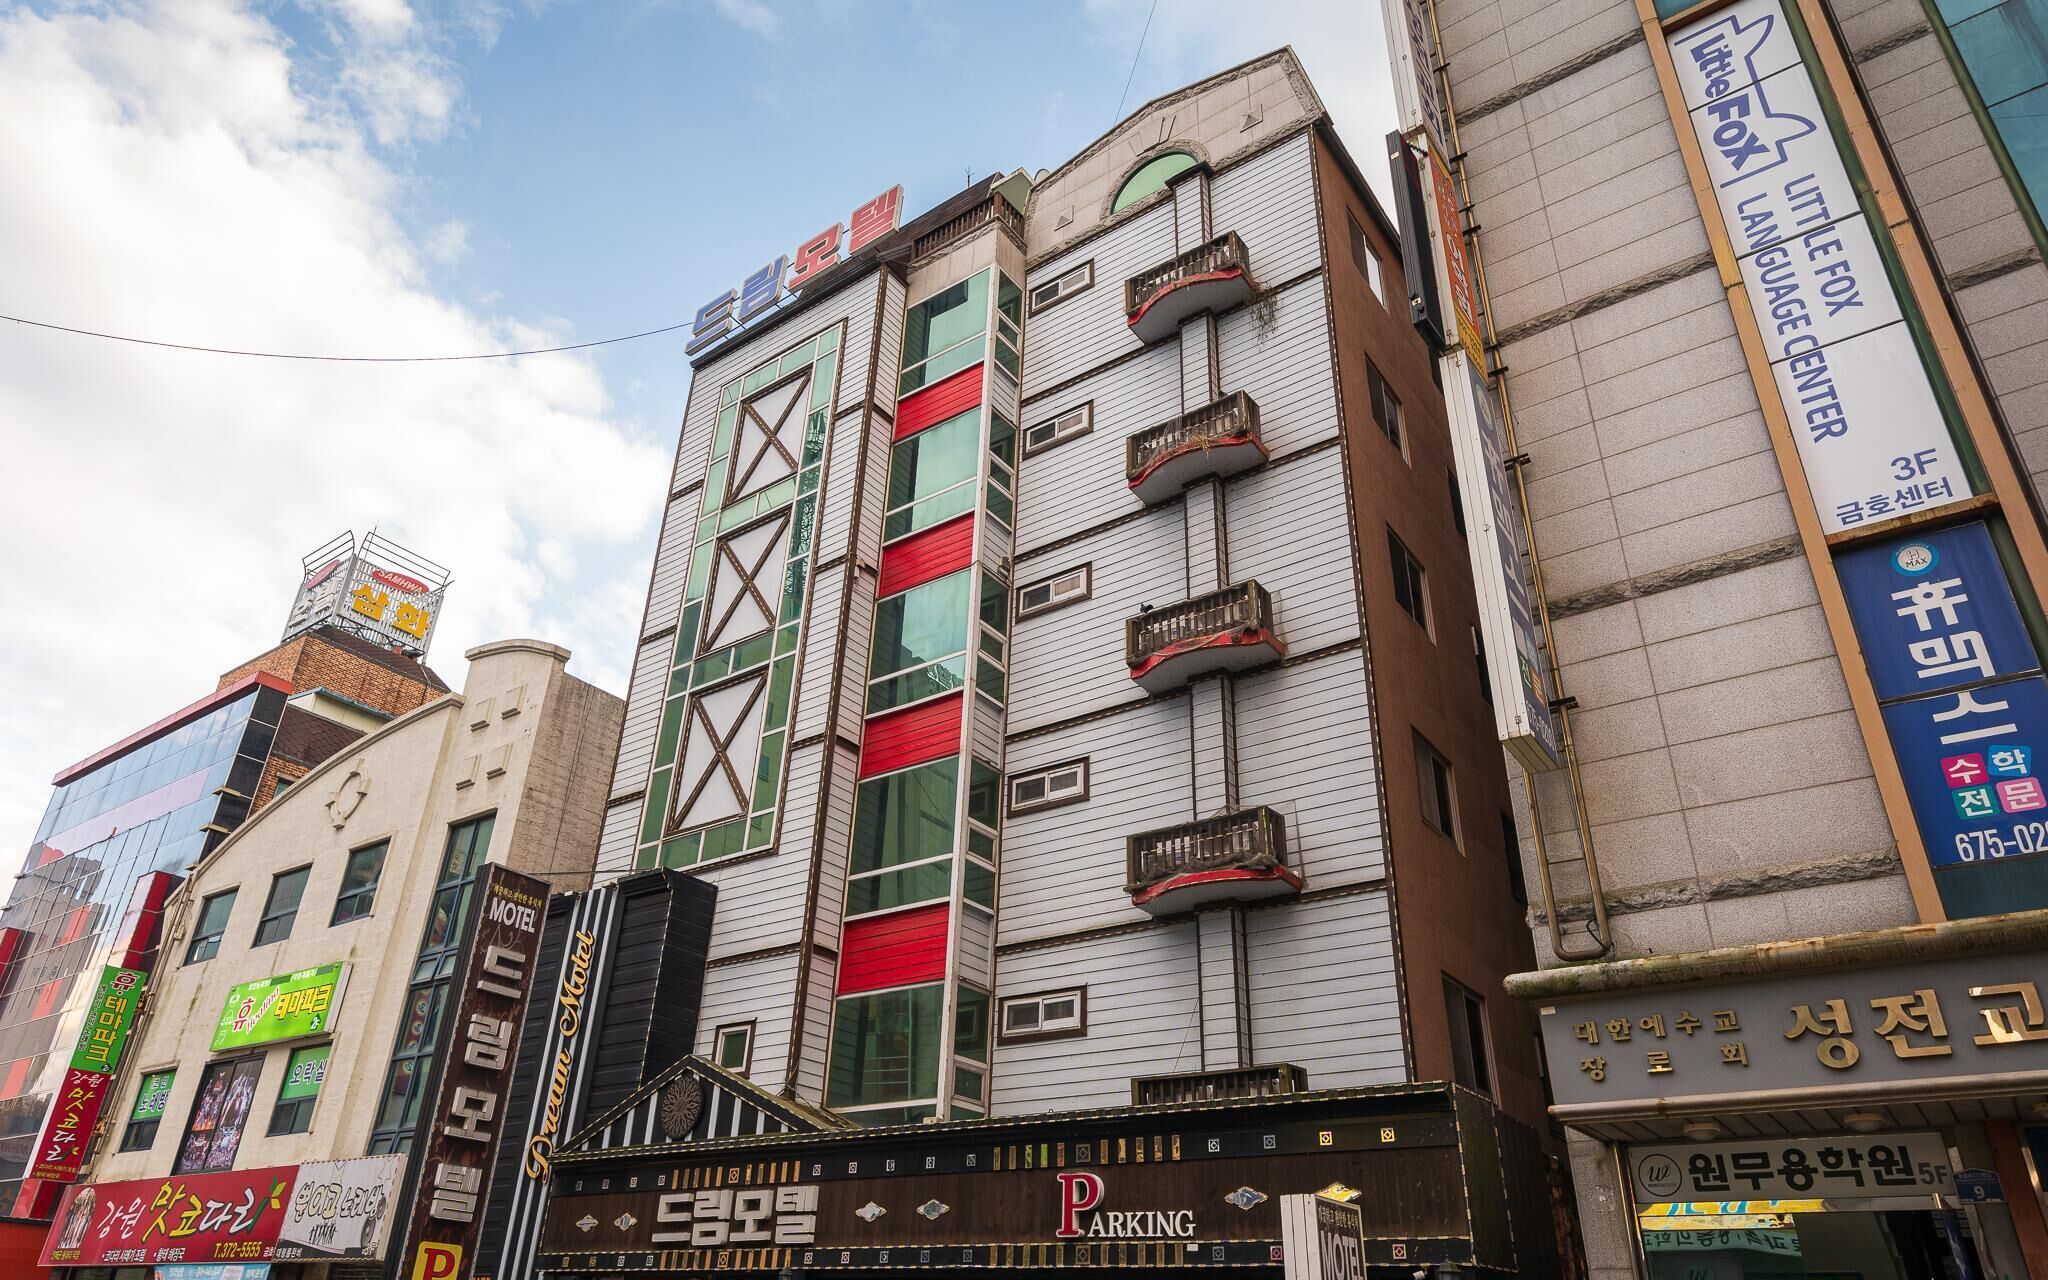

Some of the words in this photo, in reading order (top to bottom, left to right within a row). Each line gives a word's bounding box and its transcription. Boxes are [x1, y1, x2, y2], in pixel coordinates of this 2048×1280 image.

[1690, 32, 1733, 97] Little
[1784, 173, 1843, 264] LITTLE
[1814, 260, 1864, 317] FOX
[1737, 192, 1812, 336] LANGUAGE
[1783, 334, 1849, 443] CENTER
[1890, 447, 1940, 482] 3F
[1836, 477, 1953, 526] 금호센터
[378, 570, 424, 595] SAMHWA
[1948, 749, 2025, 783] 수학
[1958, 782, 2041, 817] 전문
[1955, 820, 2048, 862] 675-02
[489, 897, 535, 933] MOTEL
[1783, 981, 2048, 1070] 성전교
[289, 1058, 328, 1086] 오락실
[526, 1048, 573, 1184] Dream
[559, 929, 594, 1037] Motel
[430, 944, 526, 1223] 드림모텔
[1688, 1145, 1918, 1192] 원무용학원
[1917, 1162, 1947, 1185] 5F
[1056, 1172, 1196, 1238] PARKING
[1973, 1185, 1985, 1199] 9
[97, 1197, 146, 1240] 강원
[652, 1184, 820, 1246] 드림모텔
[214, 1241, 262, 1258] T.372-5555
[423, 1248, 456, 1280] P
[1321, 1230, 1364, 1280] MOTEL
